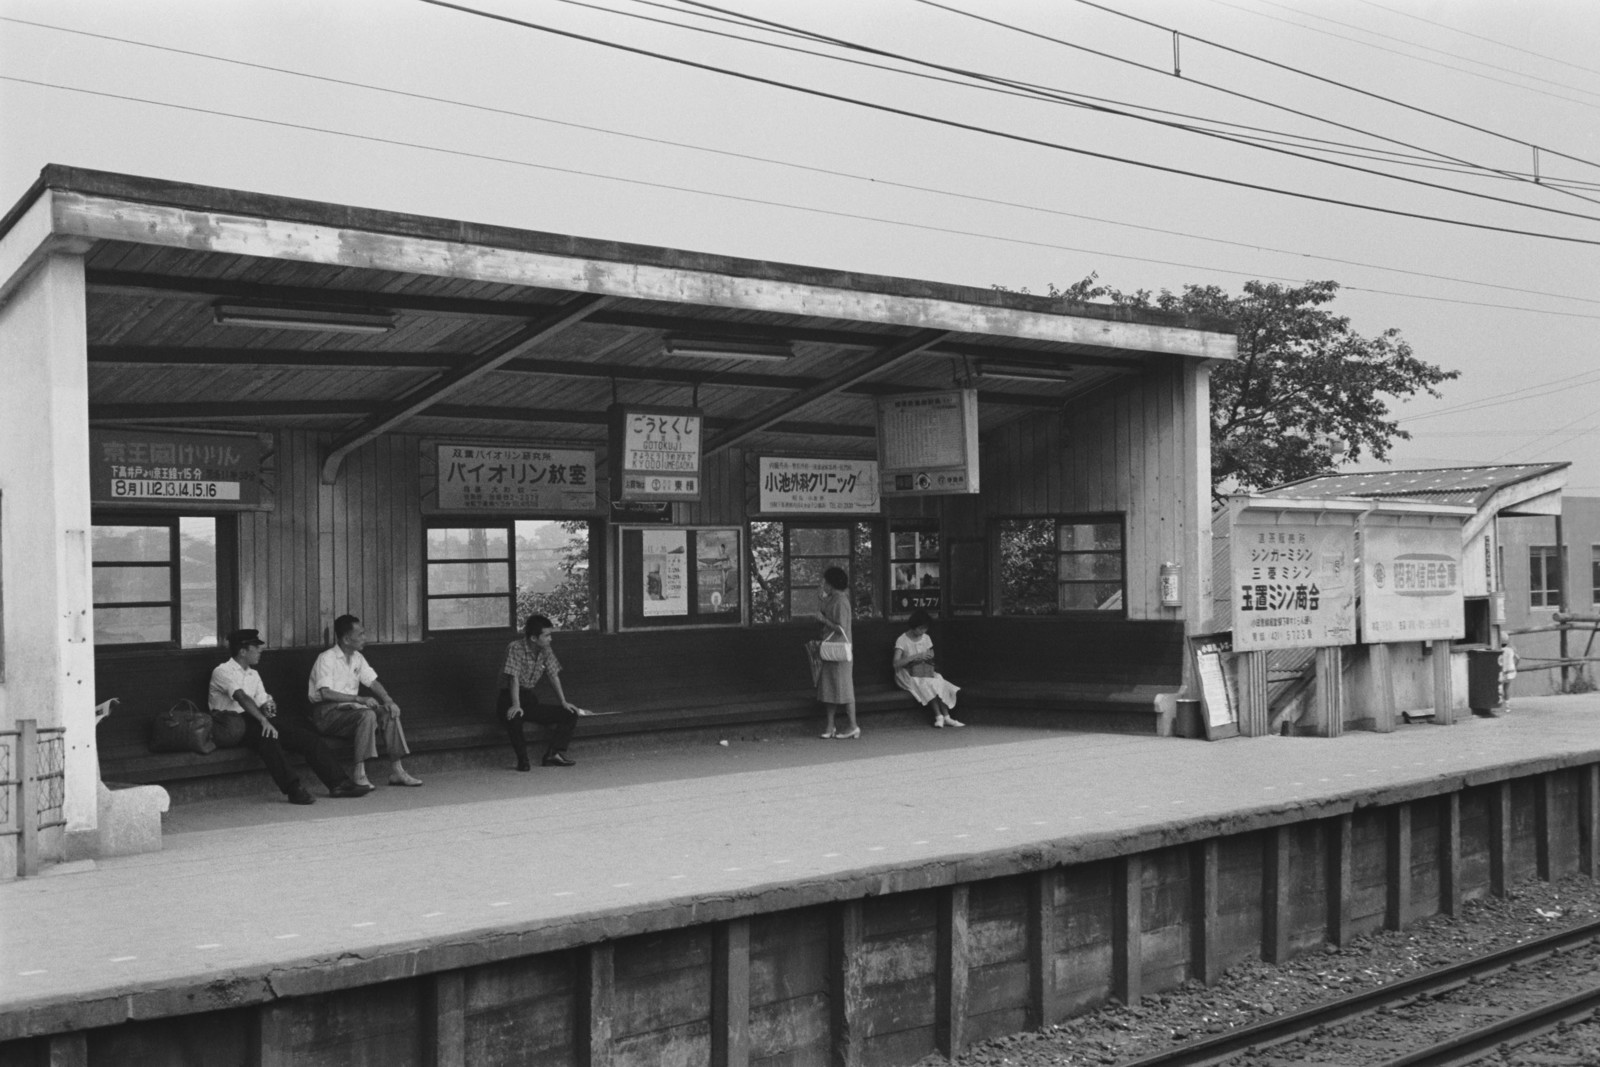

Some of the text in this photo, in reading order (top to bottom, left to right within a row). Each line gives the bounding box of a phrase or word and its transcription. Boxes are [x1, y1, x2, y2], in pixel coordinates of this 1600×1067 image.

[633, 415, 694, 434] ごうとくじ
[643, 441, 682, 451] GOTOKUJI
[447, 462, 587, 486] バイオリン教室
[632, 460, 661, 469] KYODO
[764, 472, 857, 493] 小池外科クリニック
[1251, 548, 1313, 562] シンガーミシン
[1394, 562, 1457, 589] 昭和信用金庫
[1241, 582, 1320, 611] 玉置ミシン商会
